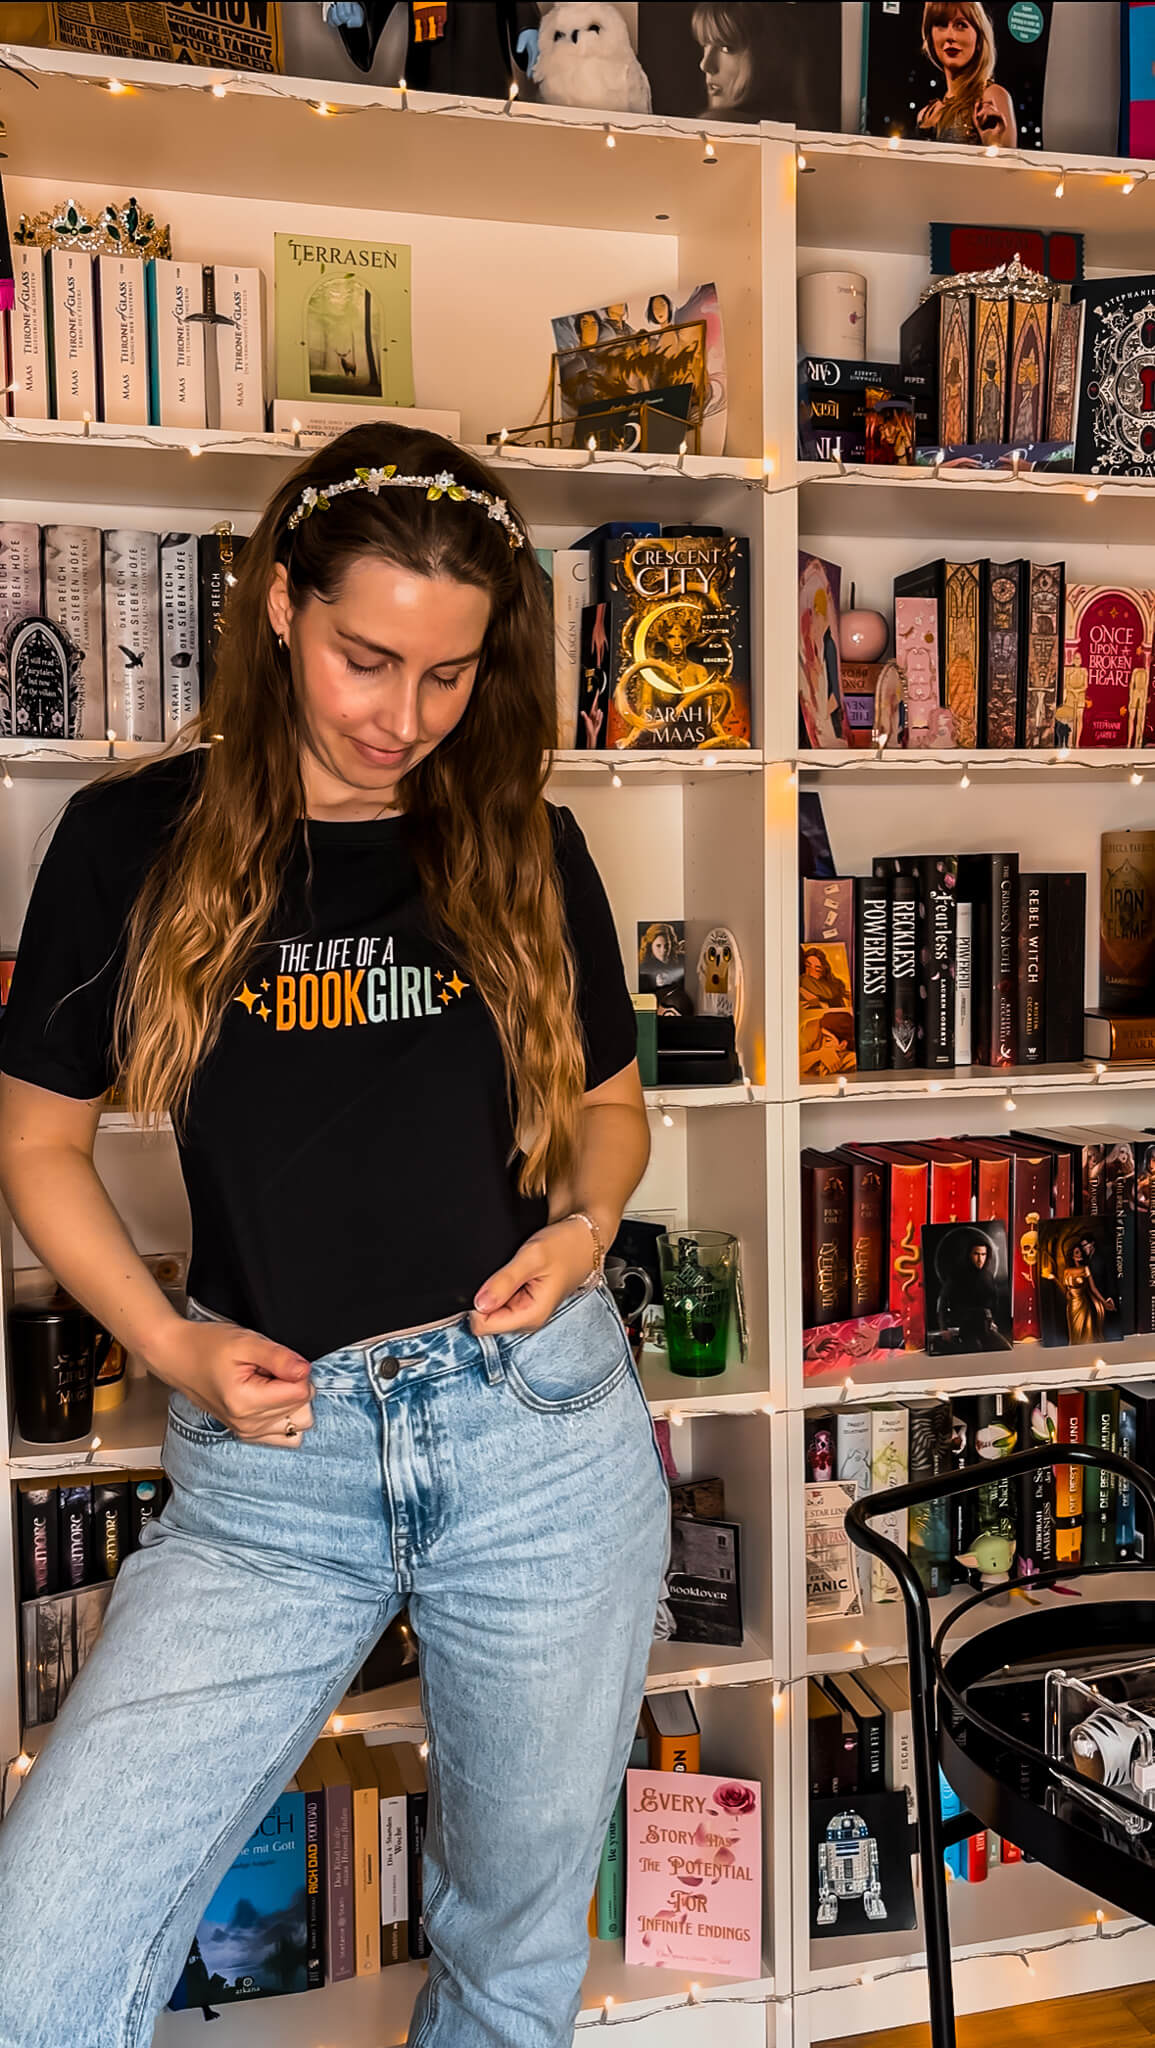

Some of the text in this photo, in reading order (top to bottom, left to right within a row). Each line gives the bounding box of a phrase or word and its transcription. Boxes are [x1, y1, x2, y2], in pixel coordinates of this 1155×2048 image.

[170, 19, 220, 45] MUGGLE
[223, 34, 273, 62] FAMILY
[172, 32, 274, 73] MURDERED
[289, 243, 398, 269] TERRASEN
[22, 271, 30, 302] GLASS
[67, 276, 76, 307] GLASS
[118, 281, 128, 312] GLASS
[175, 285, 184, 316] GLASS
[1104, 288, 1155, 308] STEPHANIE
[233, 291, 243, 322] GLASS
[23, 311, 33, 356] THRONE
[69, 317, 79, 360] THRONE
[120, 321, 130, 364] THRONE
[177, 325, 186, 368] THRONE
[234, 329, 244, 372] THRONE
[25, 365, 34, 392] MAAS
[71, 369, 79, 396] MAAS
[122, 374, 131, 400] MAAS
[178, 377, 187, 404] MAAS
[904, 376, 926, 384] PIPER
[236, 382, 245, 408] MAAS
[810, 400, 840, 420] LEGEN
[11, 540, 21, 570] HÖFE
[129, 548, 139, 577] HÖFE
[632, 549, 722, 566] CRESCENT
[58, 566, 67, 602] REICH
[70, 544, 81, 622] SIEBEN HÖFE
[165, 572, 174, 608] REICH
[212, 572, 221, 607] REICH
[636, 567, 718, 595] CITY
[117, 570, 127, 629] DAS REICH
[130, 585, 140, 630] SIEBEN
[175, 550, 188, 649] DER SIEBEN HÖFE
[1089, 625, 1134, 644] ONCE
[1089, 643, 1120, 656] UPON
[1089, 655, 1132, 671] BROKEN
[1089, 669, 1132, 688] HEART
[136, 679, 145, 712] MAAS
[172, 683, 180, 721] SARAH
[184, 680, 193, 713] MAAS
[644, 706, 703, 723] SARAH
[652, 726, 706, 743] MAAS
[1000, 880, 1011, 935] CRIMSON
[1110, 887, 1145, 912] IRON
[892, 900, 916, 979] RECKLESS
[1027, 889, 1040, 984] REBEL WITCH
[1106, 918, 1146, 939] FLAME
[279, 936, 394, 973] THE LIFE OF A
[863, 899, 887, 996] POWERLESS
[1000, 936, 1011, 974] MOTH
[929, 889, 956, 1047] Fearless LAUREN ROBERTS
[276, 966, 442, 1031] BOOKGIRL
[1115, 1226, 1125, 1256] FALLEN
[811, 1509, 830, 1517] STAR
[1099, 1491, 1109, 1508] DIE
[1035, 1511, 1043, 1552] DEBORAH
[1043, 1502, 1051, 1560] HARKNESS
[807, 1579, 849, 1593] TANIC
[870, 1726, 880, 1773] ALEX FLINN
[900, 1734, 909, 1770] ESCAPE
[633, 1787, 708, 1815] EVERY
[253, 1844, 270, 1855] mit
[272, 1840, 296, 1853] Gott
[608, 1822, 619, 1845] your
[640, 1824, 733, 1848] STORY HAS
[307, 1843, 319, 1868] DAD
[607, 1848, 617, 1862] Be
[639, 1855, 754, 1881] THE POTENTIAL
[308, 1869, 320, 1894] RICH
[667, 1890, 709, 1914] FOR
[637, 1915, 751, 1942] INFINITE ENDINGS
